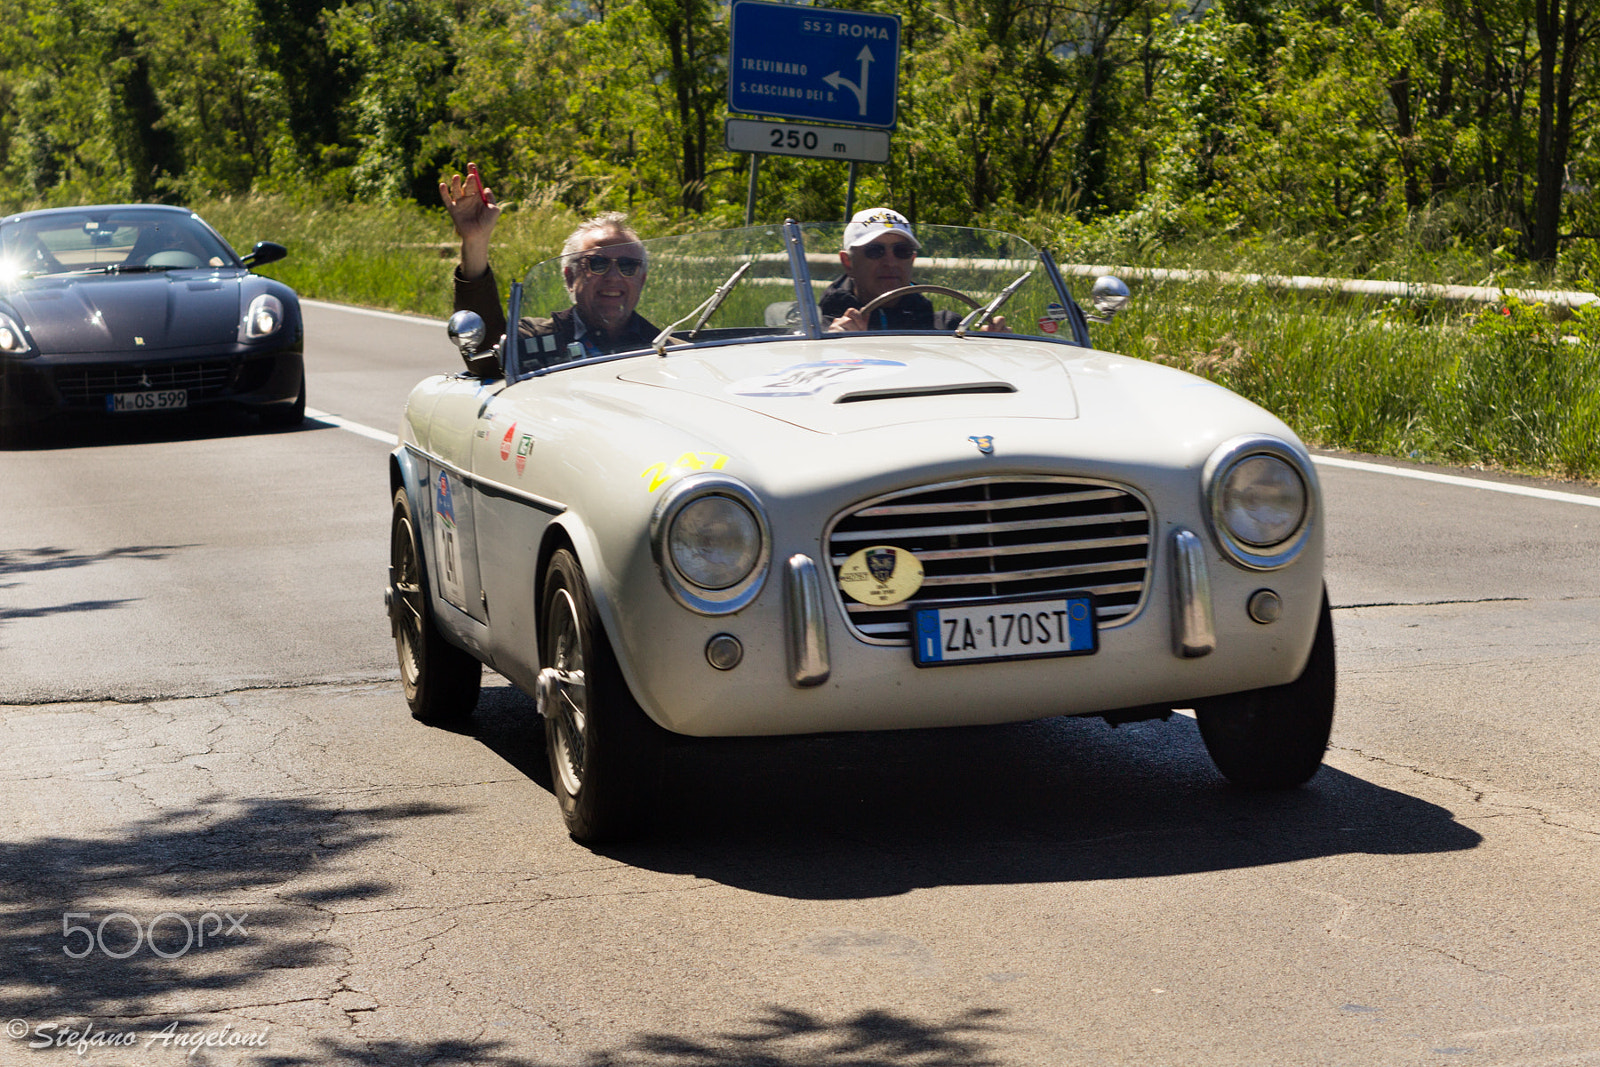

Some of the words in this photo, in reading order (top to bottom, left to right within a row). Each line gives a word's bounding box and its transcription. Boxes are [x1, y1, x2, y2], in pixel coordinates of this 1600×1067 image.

[803, 20, 821, 32] SS
[824, 22, 833, 33] 2
[838, 23, 889, 40] ROMA
[741, 57, 808, 76] TREVINANO
[806, 89, 823, 101] DEI
[770, 128, 818, 150] 250
[833, 142, 846, 152] m
[114, 395, 125, 409] M
[158, 390, 186, 407] 599
[640, 451, 730, 493] 247
